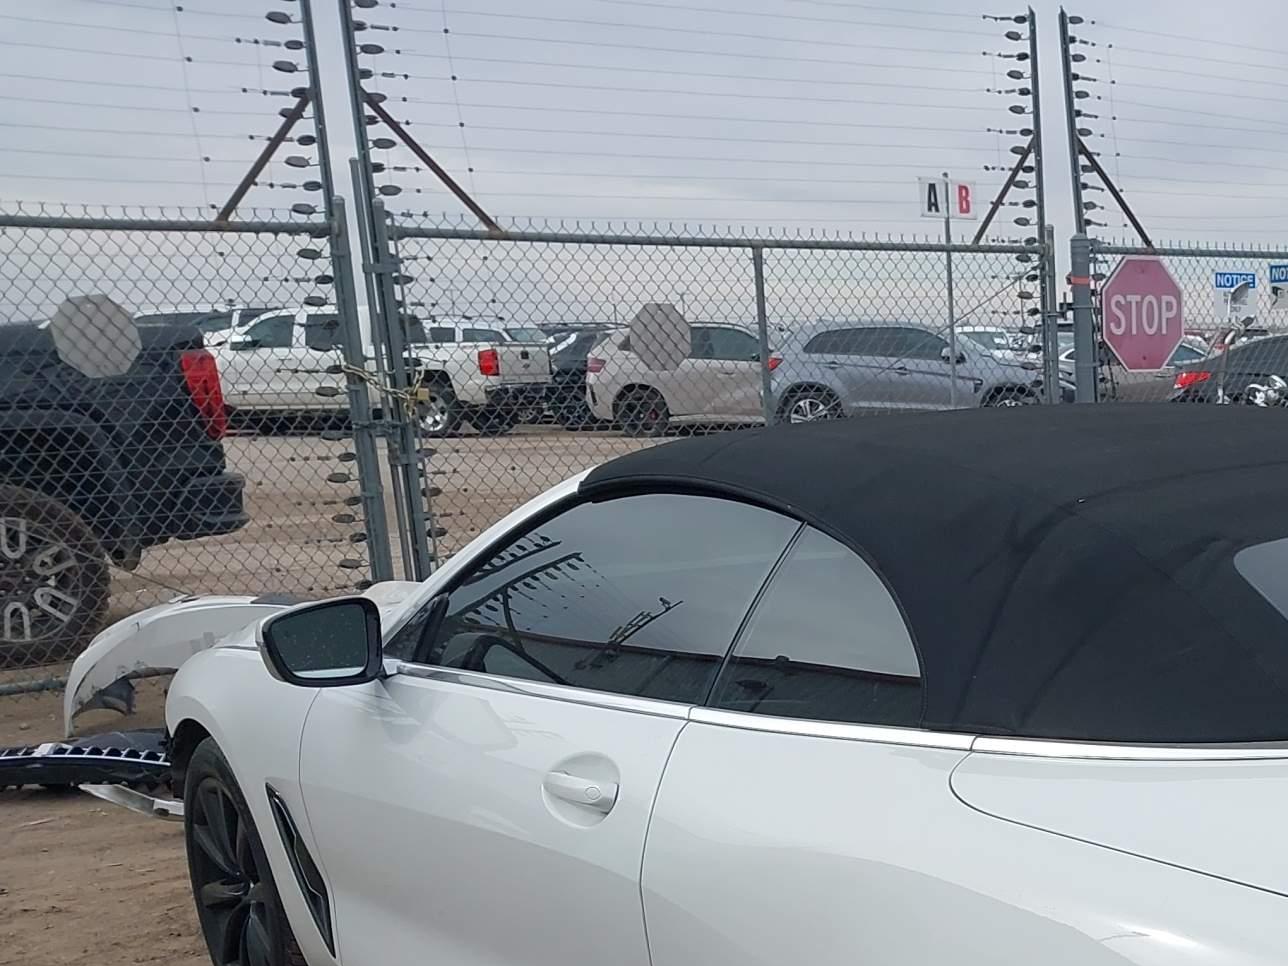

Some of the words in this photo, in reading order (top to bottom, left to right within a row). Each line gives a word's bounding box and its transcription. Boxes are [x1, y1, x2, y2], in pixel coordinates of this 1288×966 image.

[927, 182, 940, 213] A
[958, 184, 971, 214] B
[1110, 294, 1178, 336] STOP
